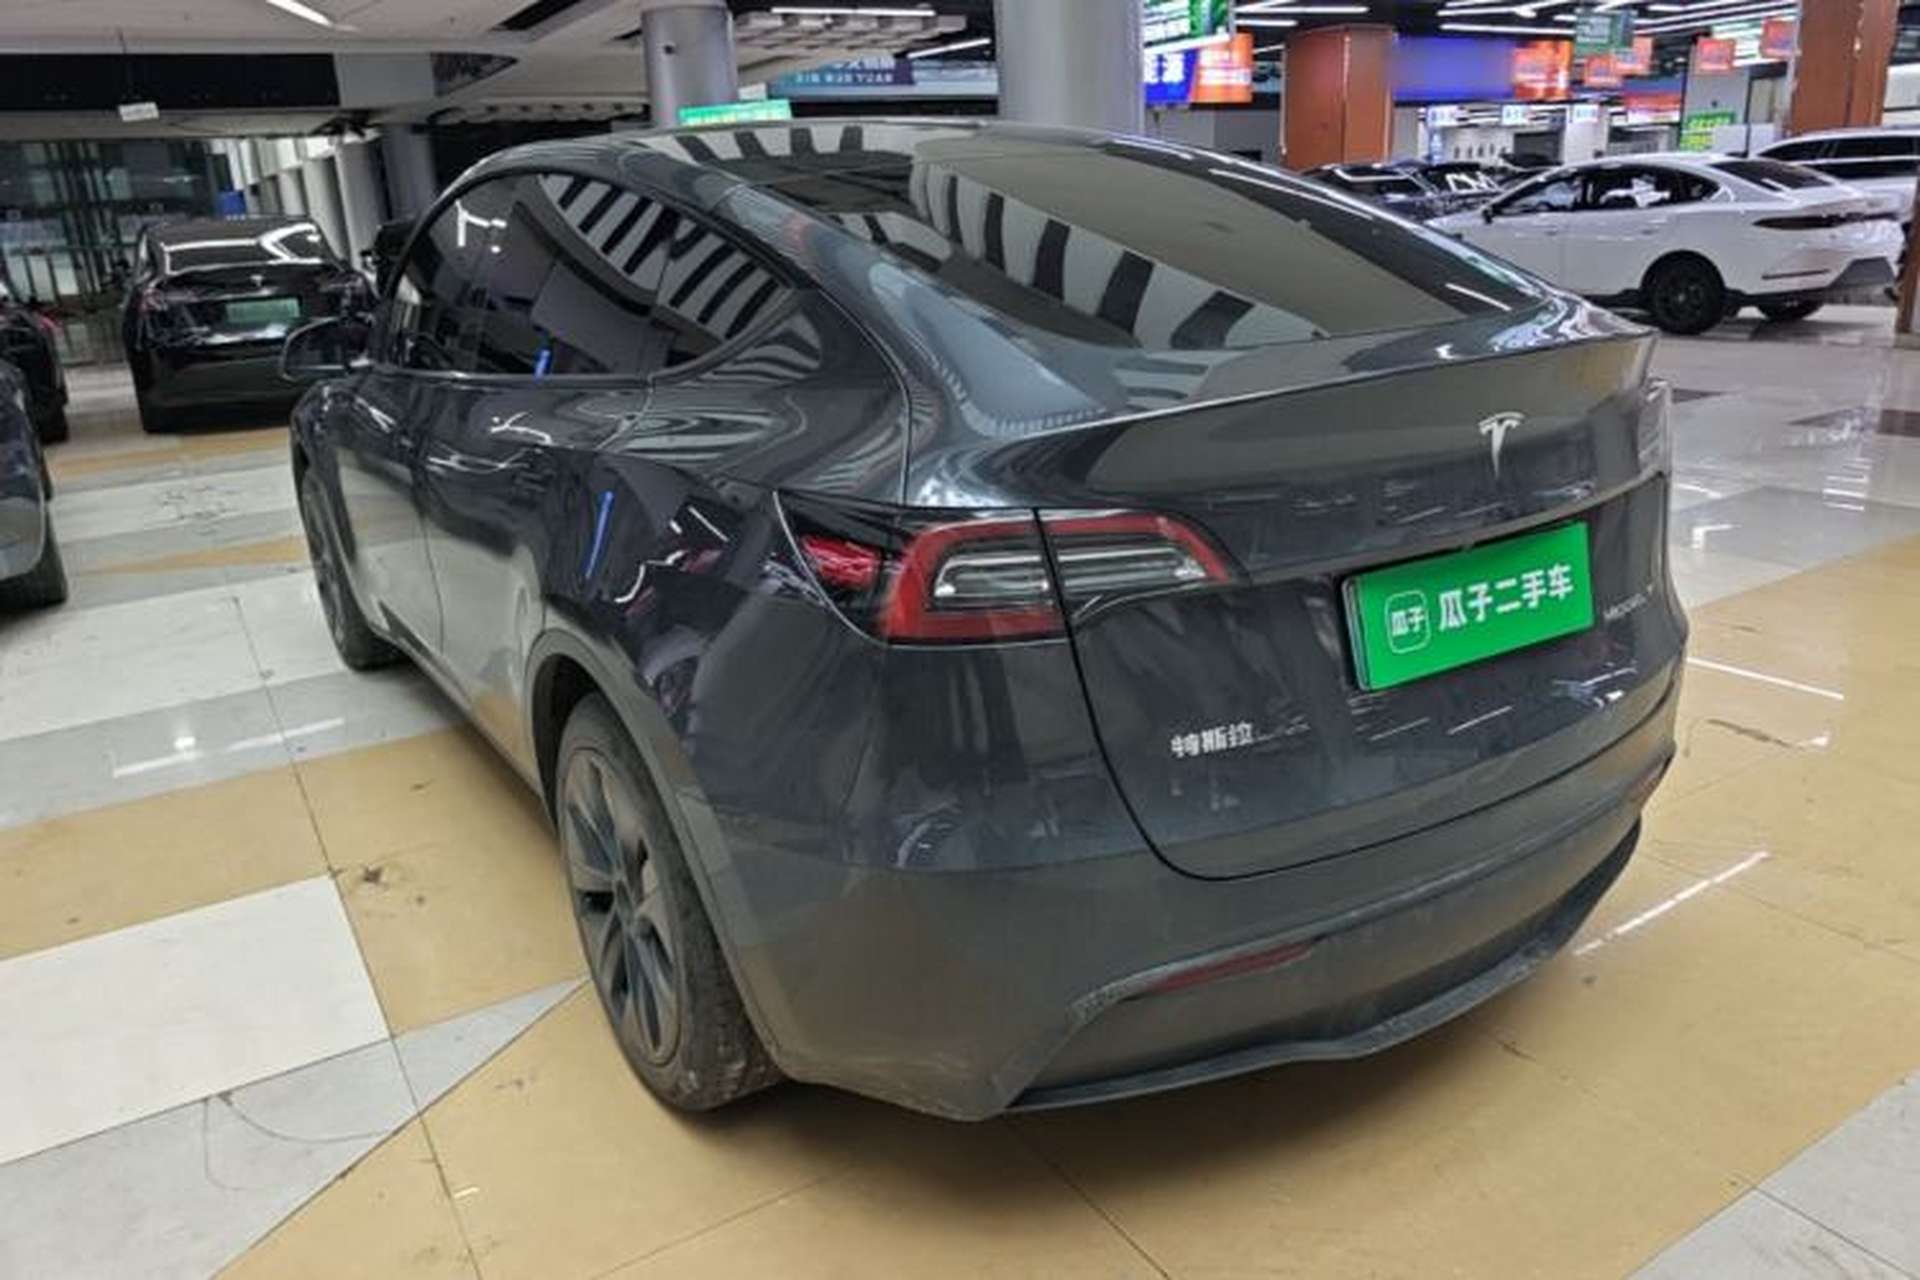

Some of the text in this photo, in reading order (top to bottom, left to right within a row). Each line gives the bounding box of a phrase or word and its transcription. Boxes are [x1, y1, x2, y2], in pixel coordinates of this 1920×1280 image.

[1438, 563, 1574, 632] 瓜子二手车
[1391, 606, 1425, 636] 瓜子
[1170, 721, 1252, 758] 特斯拉
